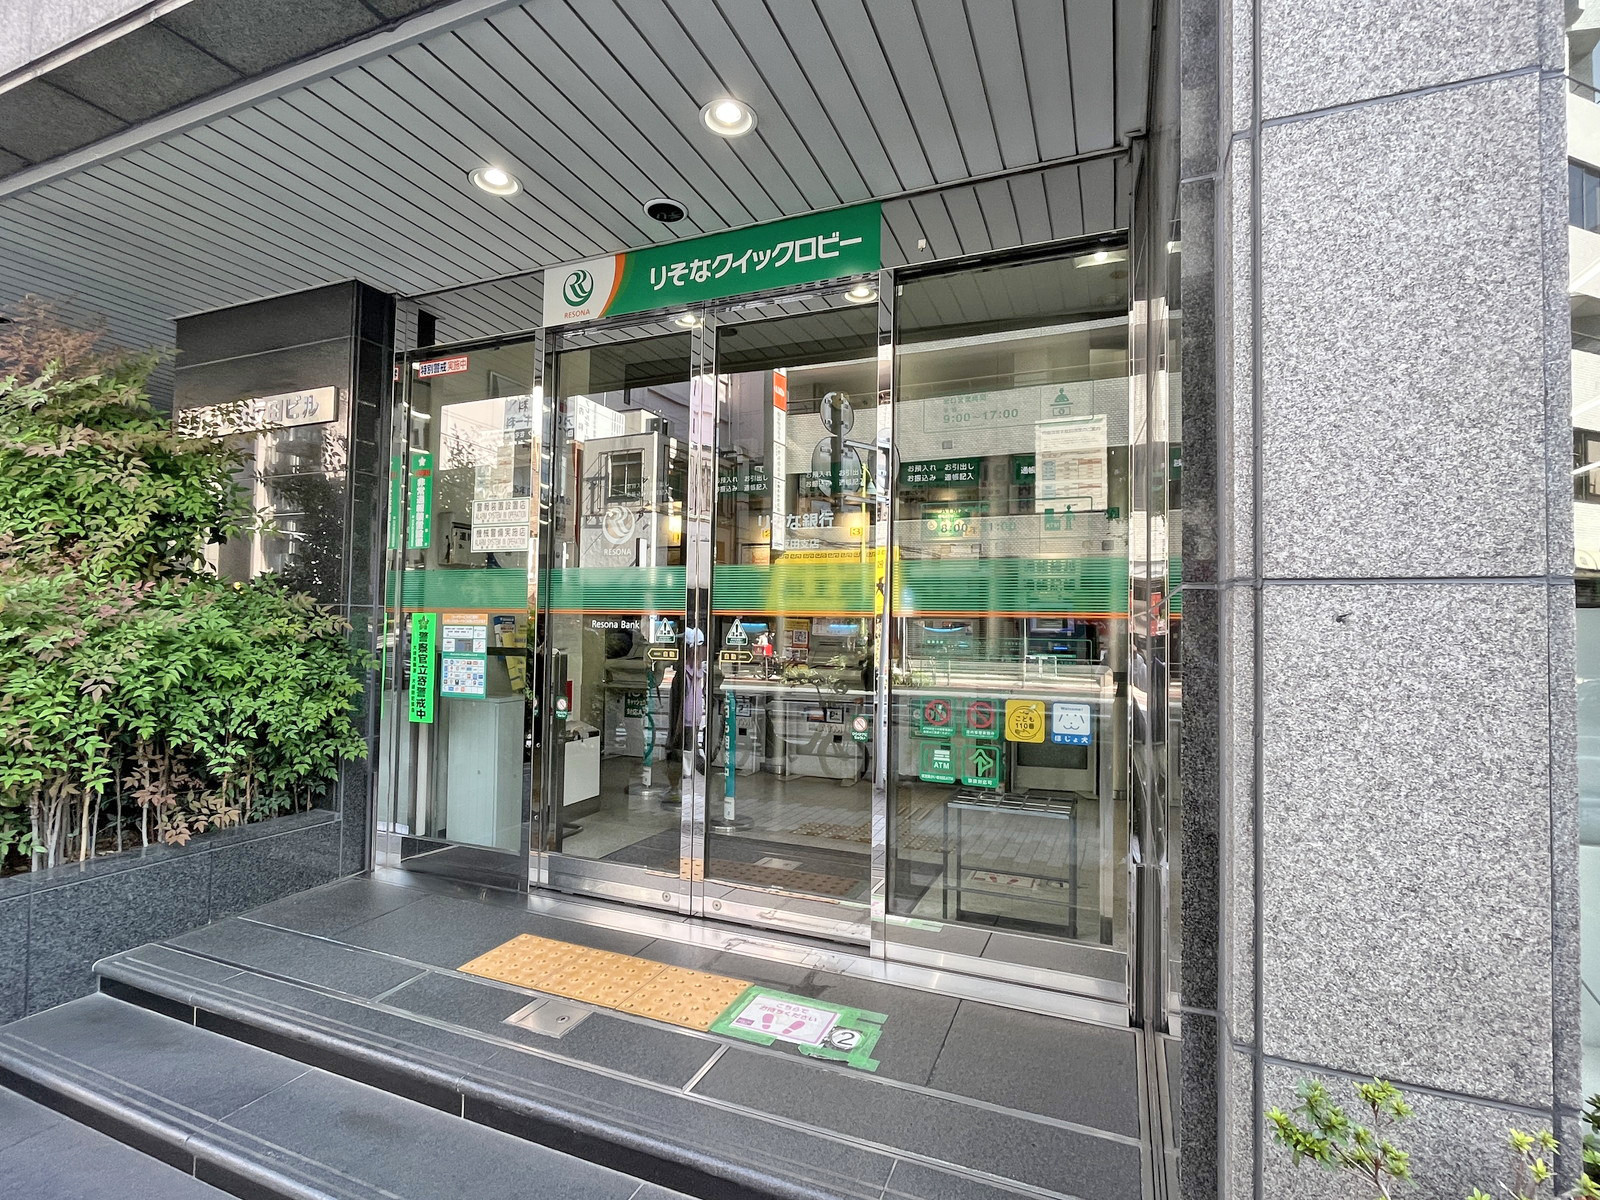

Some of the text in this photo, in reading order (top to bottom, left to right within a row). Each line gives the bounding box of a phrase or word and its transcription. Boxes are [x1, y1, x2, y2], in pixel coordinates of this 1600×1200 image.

[650, 231, 863, 291] りそなクイックロビー
[563, 309, 591, 319] RESONA
[420, 358, 467, 376] 特別警戒実施中
[907, 462, 975, 474] お預入れ お引出し
[744, 474, 768, 483] お引出し
[944, 472, 974, 482] 通帳記入
[487, 511, 502, 519] SYSTEM
[507, 510, 527, 519] OPERATION
[757, 509, 834, 530] りな銀行
[476, 527, 526, 538] 機械警備実施店
[487, 538, 502, 546] SYSTEM
[506, 537, 526, 546] OPERATION
[603, 548, 632, 556] RESONA
[591, 619, 640, 630] Resona Bank
[415, 631, 429, 720] 警察官立寄警戒中
[1015, 715, 1035, 723] こども
[1054, 735, 1089, 745] ほじょ犬
[933, 761, 950, 770] ATM
[759, 1004, 818, 1022] お待ちください
[776, 1003, 810, 1014] こちらで
